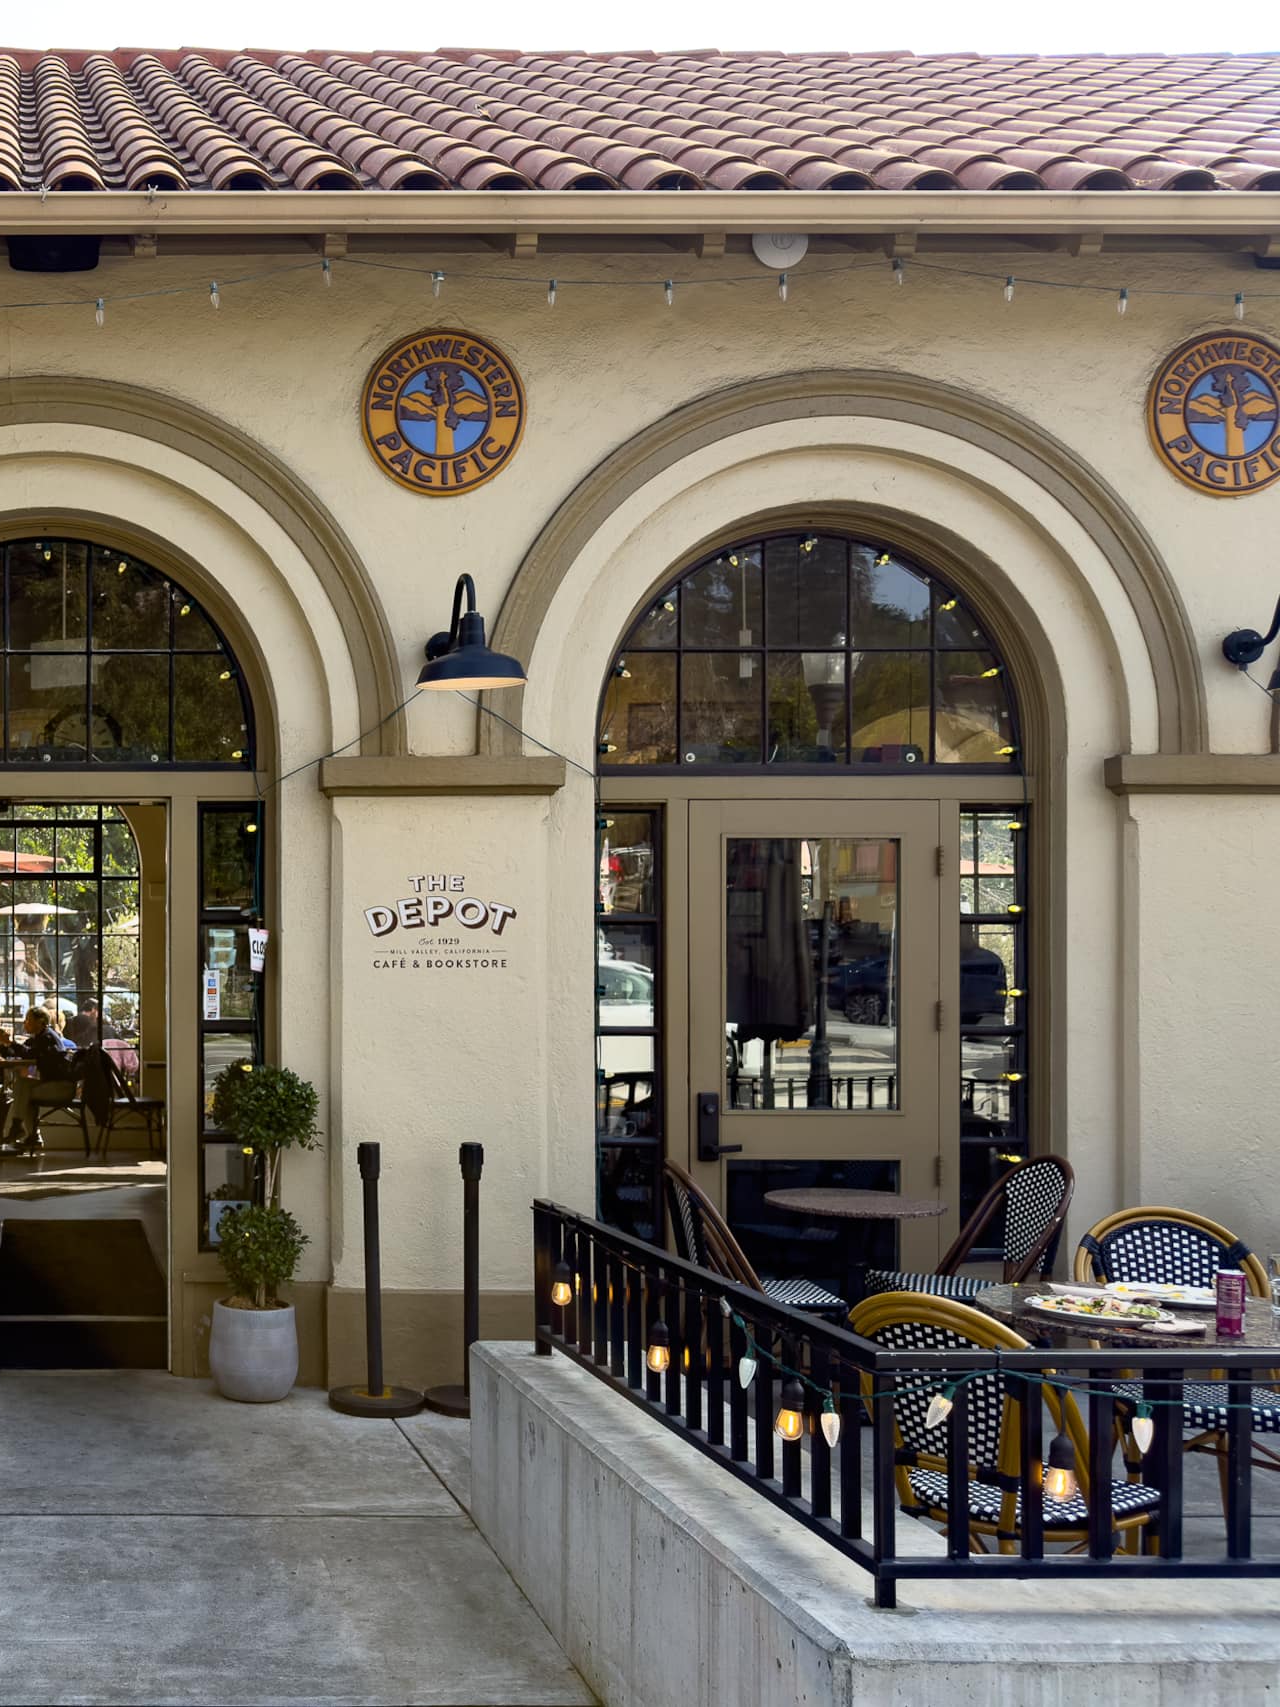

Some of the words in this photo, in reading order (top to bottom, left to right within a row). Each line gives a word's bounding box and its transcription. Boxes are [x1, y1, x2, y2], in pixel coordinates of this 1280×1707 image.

[371, 339, 517, 417] NORTHWESTERN
[376, 431, 506, 485] PACIFIC
[408, 875, 465, 892] THE
[364, 896, 517, 937] DEPOT
[438, 937, 460, 945] 1929
[373, 957, 406, 968] CAFÉ
[412, 959, 420, 968] &
[426, 959, 507, 968] BOOKSTORE
